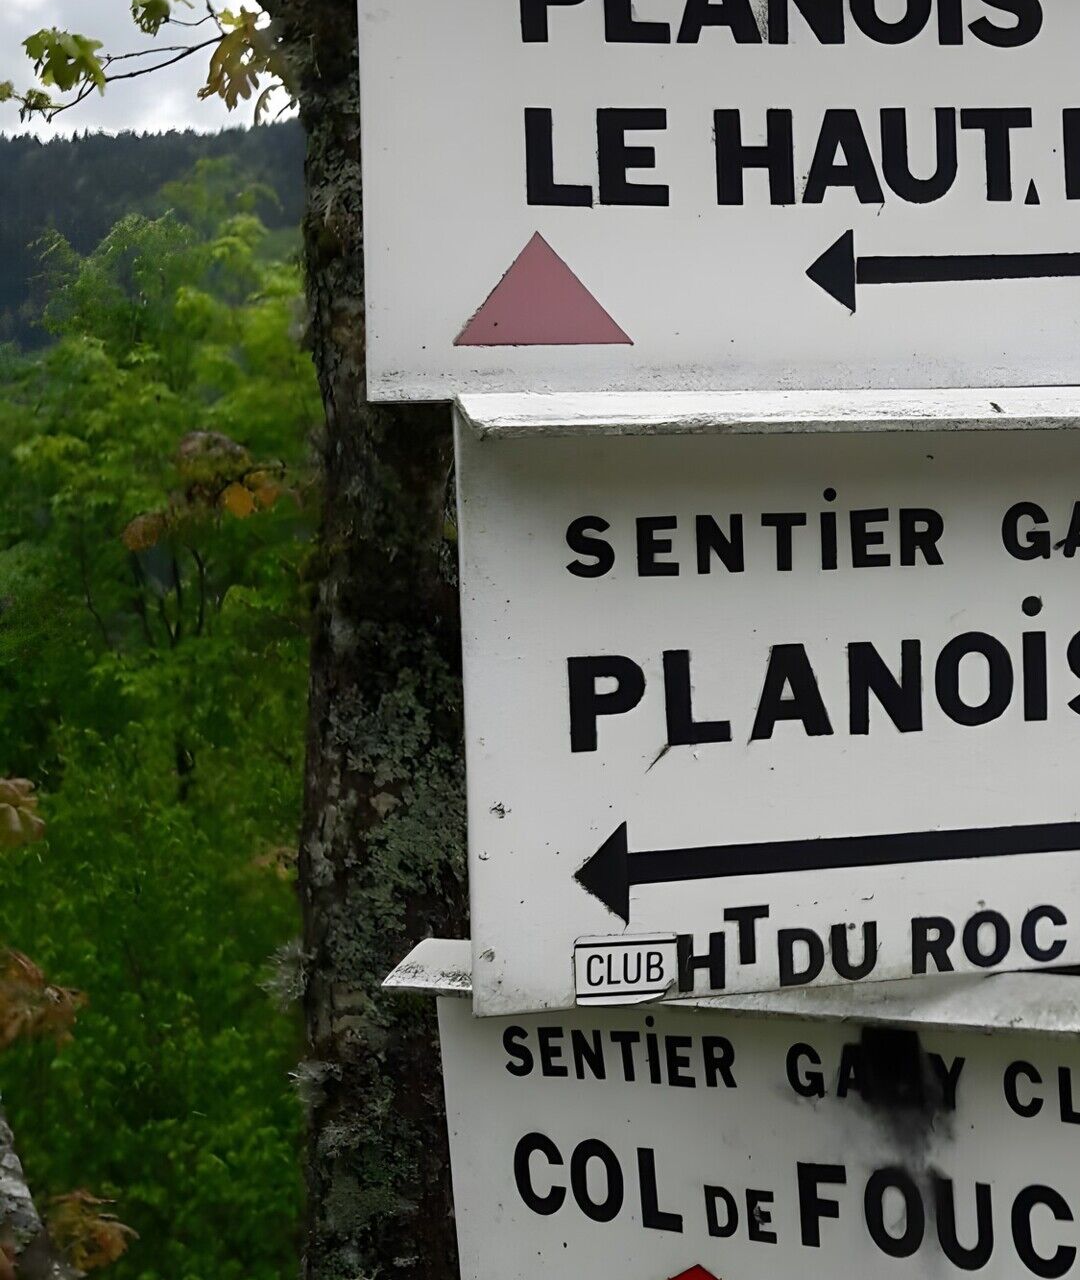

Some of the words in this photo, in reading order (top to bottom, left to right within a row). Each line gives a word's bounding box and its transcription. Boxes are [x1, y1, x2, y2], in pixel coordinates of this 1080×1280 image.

[525, 108, 669, 208] LE
[585, 951, 664, 986] CLUB
[778, 921, 877, 987] DU
[911, 904, 1067, 974] ROC
[514, 1133, 683, 1233] COL
[704, 1185, 777, 1244] DE
